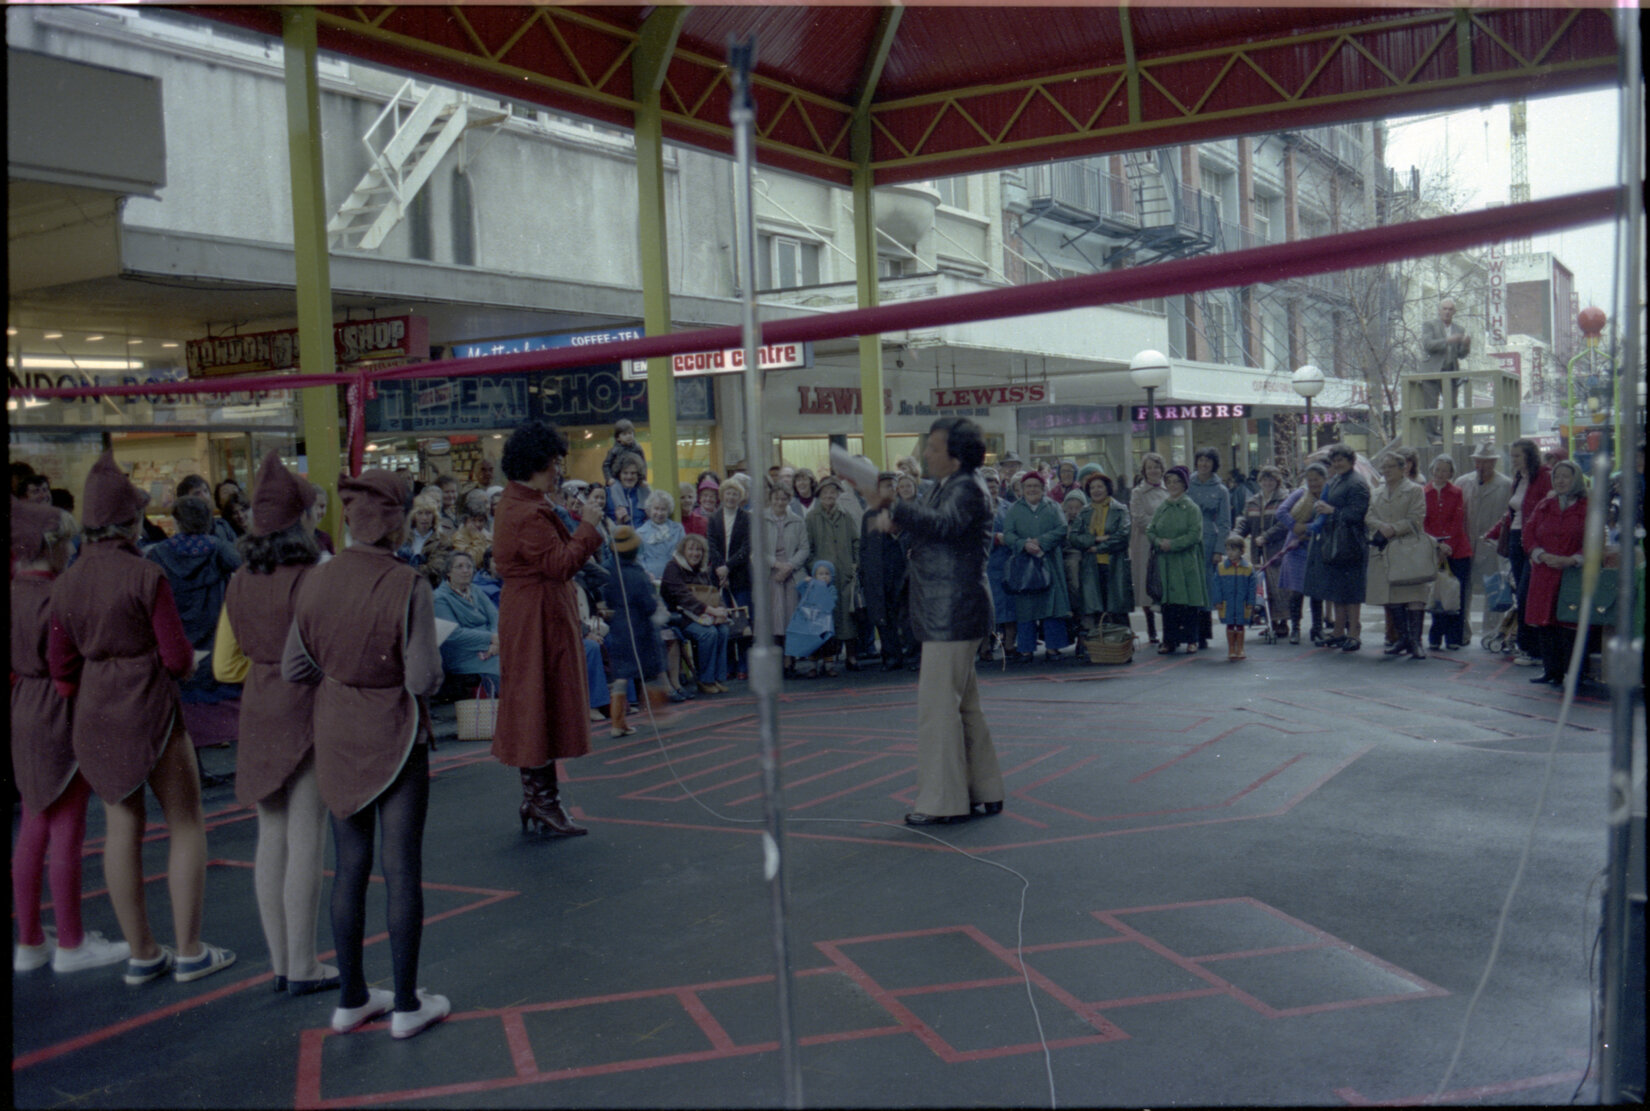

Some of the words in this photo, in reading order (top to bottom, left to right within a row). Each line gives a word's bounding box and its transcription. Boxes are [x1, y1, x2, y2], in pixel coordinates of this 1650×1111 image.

[1489, 247, 1503, 341] LWORTHS
[341, 320, 405, 361] SHOP
[674, 347, 725, 372] ecord
[731, 345, 796, 368] cntre
[541, 372, 646, 416] SHOP
[936, 385, 1045, 407] LEWIS'S
[1137, 404, 1244, 421] FARMERS
